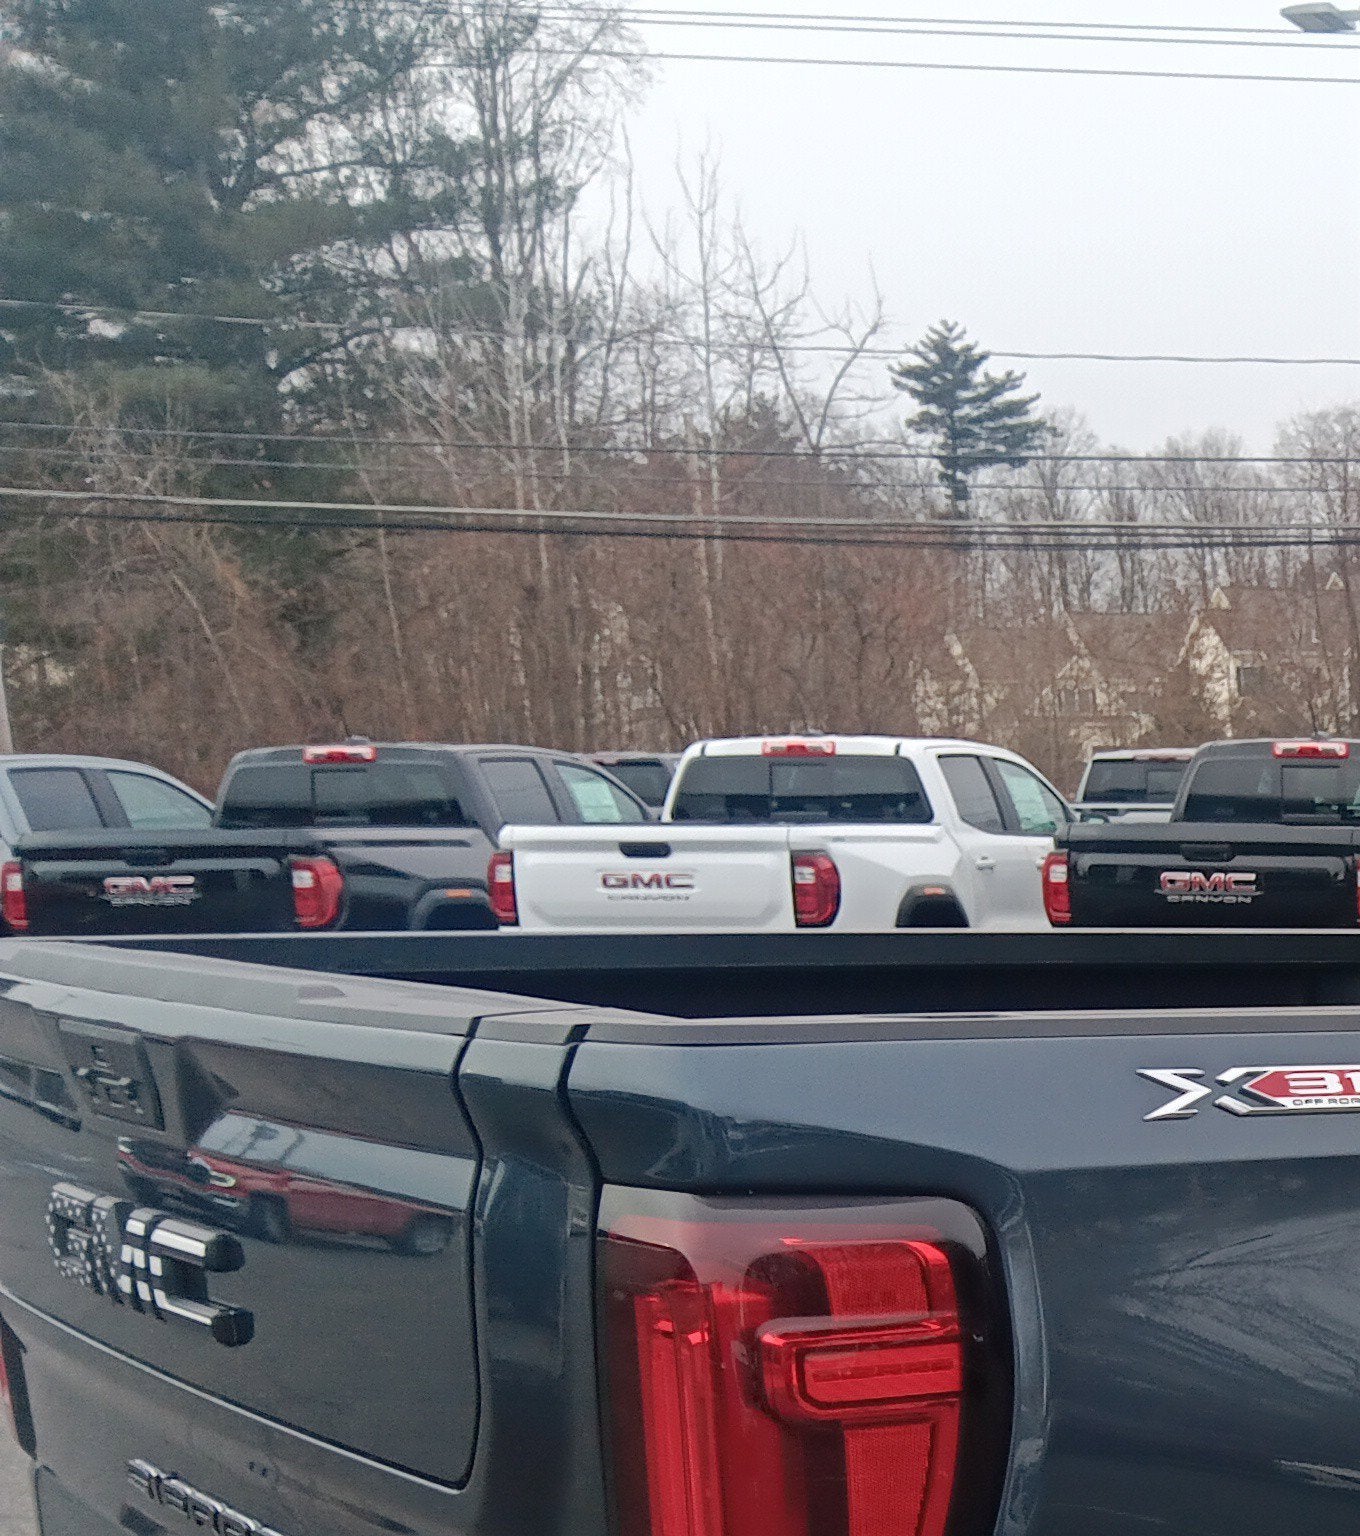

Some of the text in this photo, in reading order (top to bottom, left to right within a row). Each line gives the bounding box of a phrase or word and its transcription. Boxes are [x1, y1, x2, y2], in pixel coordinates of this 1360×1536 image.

[103, 876, 196, 894] GMC
[602, 874, 695, 889] GMC
[1160, 871, 1257, 892] GMC
[1292, 1098, 1324, 1107] OFF
